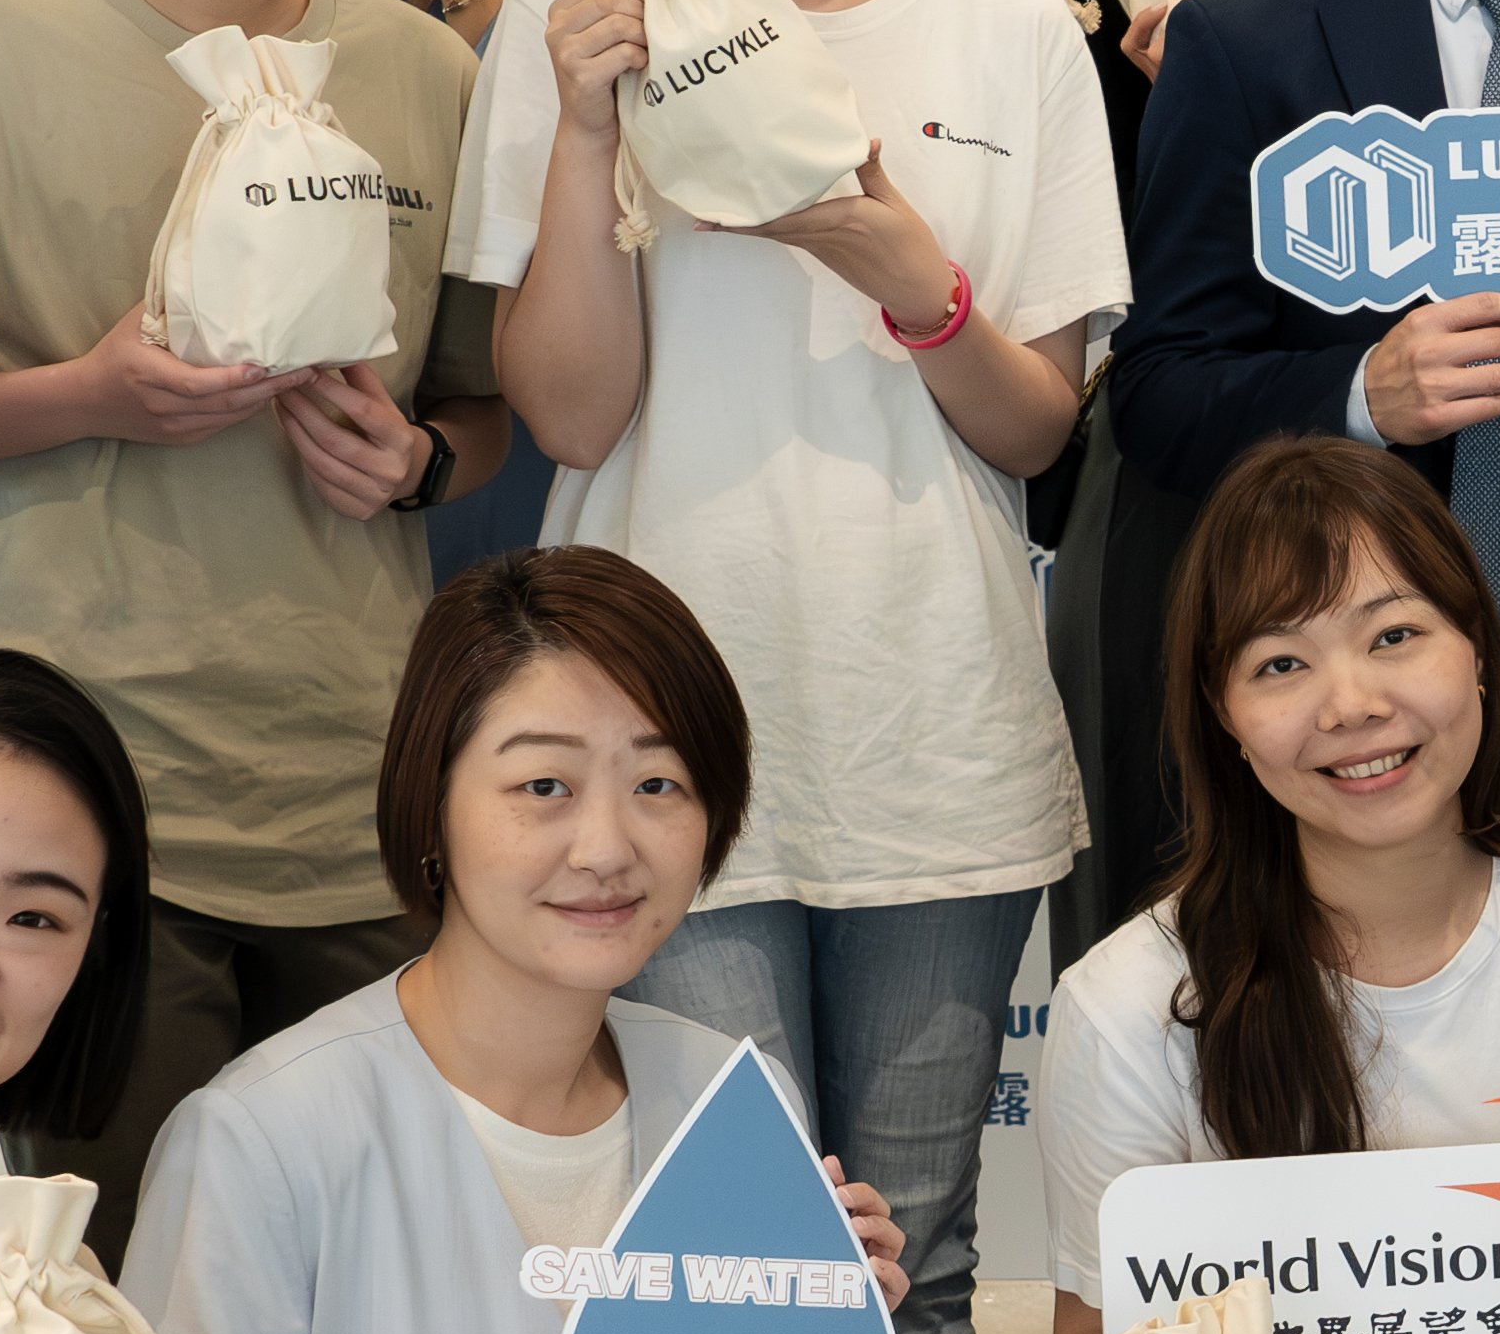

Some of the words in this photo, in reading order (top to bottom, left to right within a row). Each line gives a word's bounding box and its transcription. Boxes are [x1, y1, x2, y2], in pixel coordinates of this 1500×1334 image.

[665, 17, 780, 95] LUCYKLE
[922, 121, 1012, 157] Champion
[287, 173, 383, 202] LUCYKLE
[528, 1249, 672, 1300] SAVE
[686, 1255, 867, 1308] WATER
